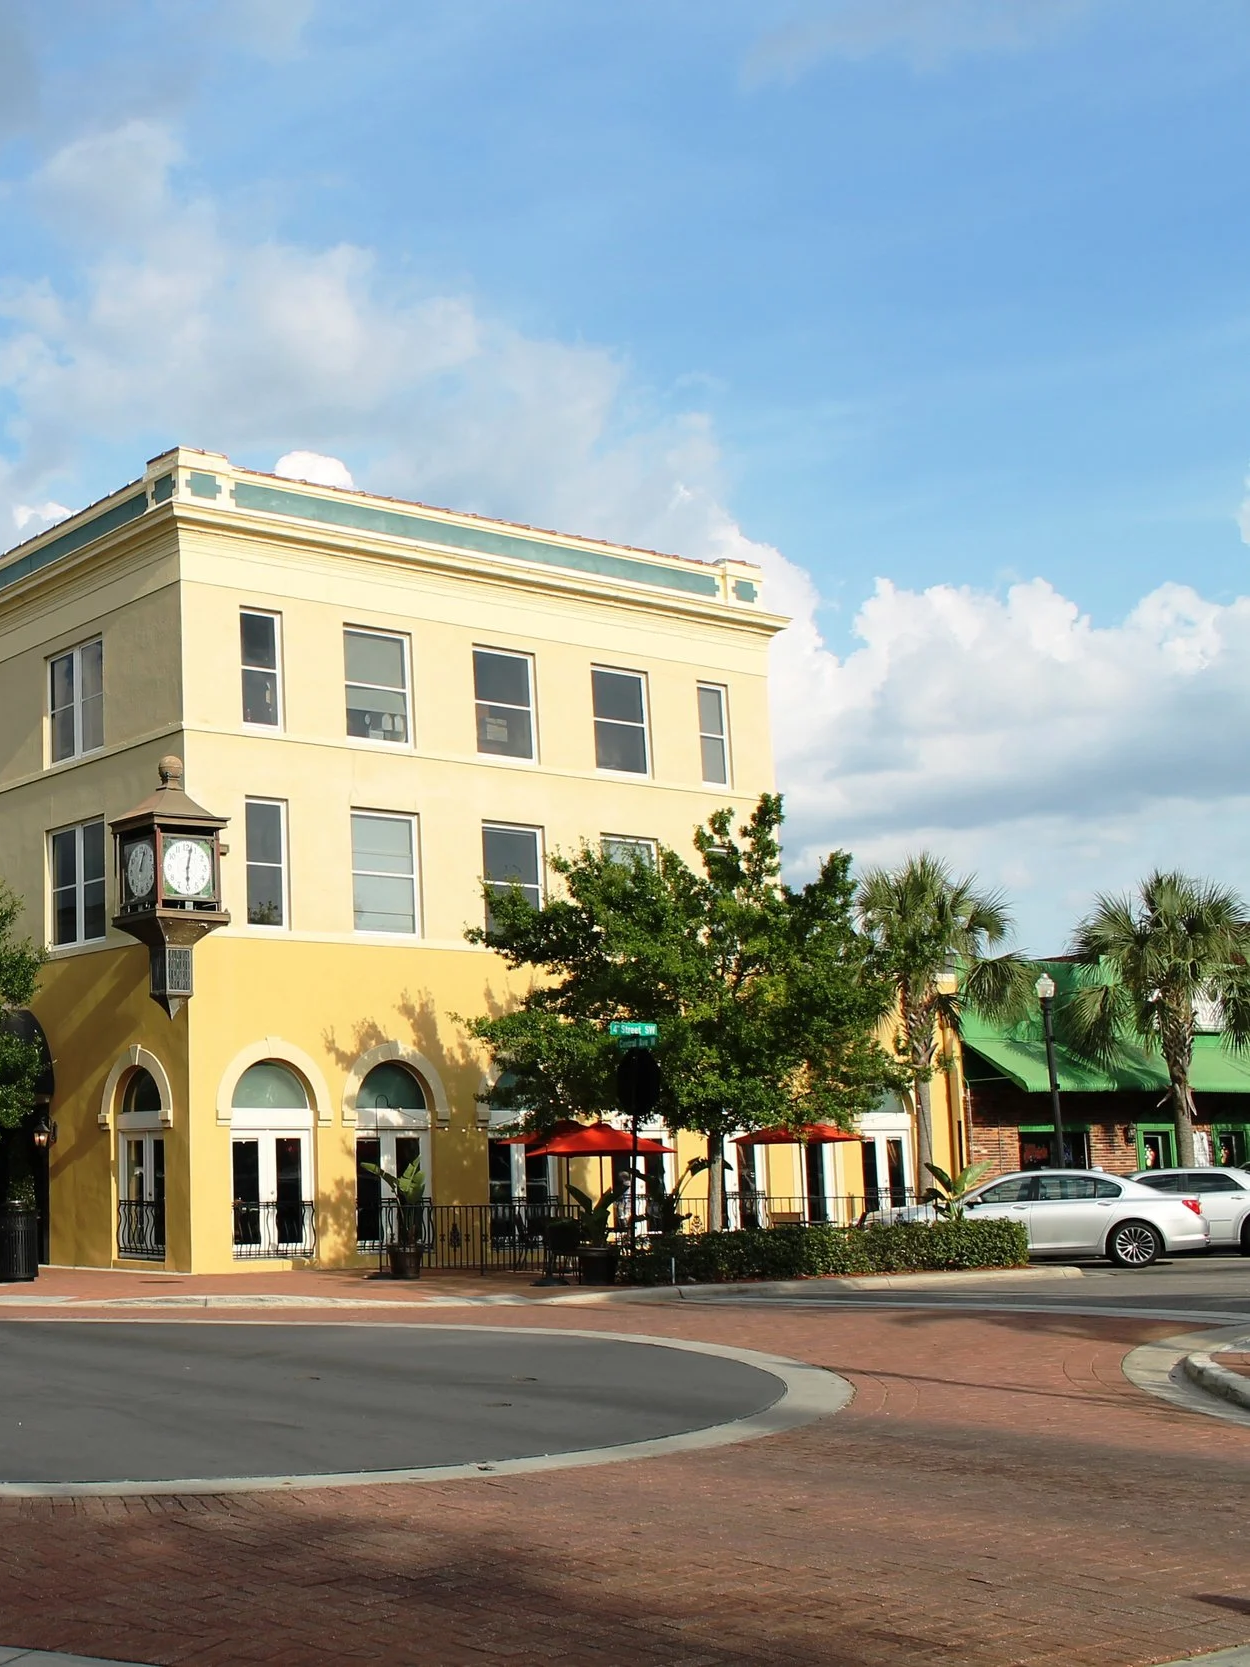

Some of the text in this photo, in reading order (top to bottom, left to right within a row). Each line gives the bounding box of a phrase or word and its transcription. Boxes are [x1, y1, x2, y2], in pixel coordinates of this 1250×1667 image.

[182, 843, 190, 851] 12
[621, 1025, 641, 1035] Street
[644, 1025, 655, 1035] SW
